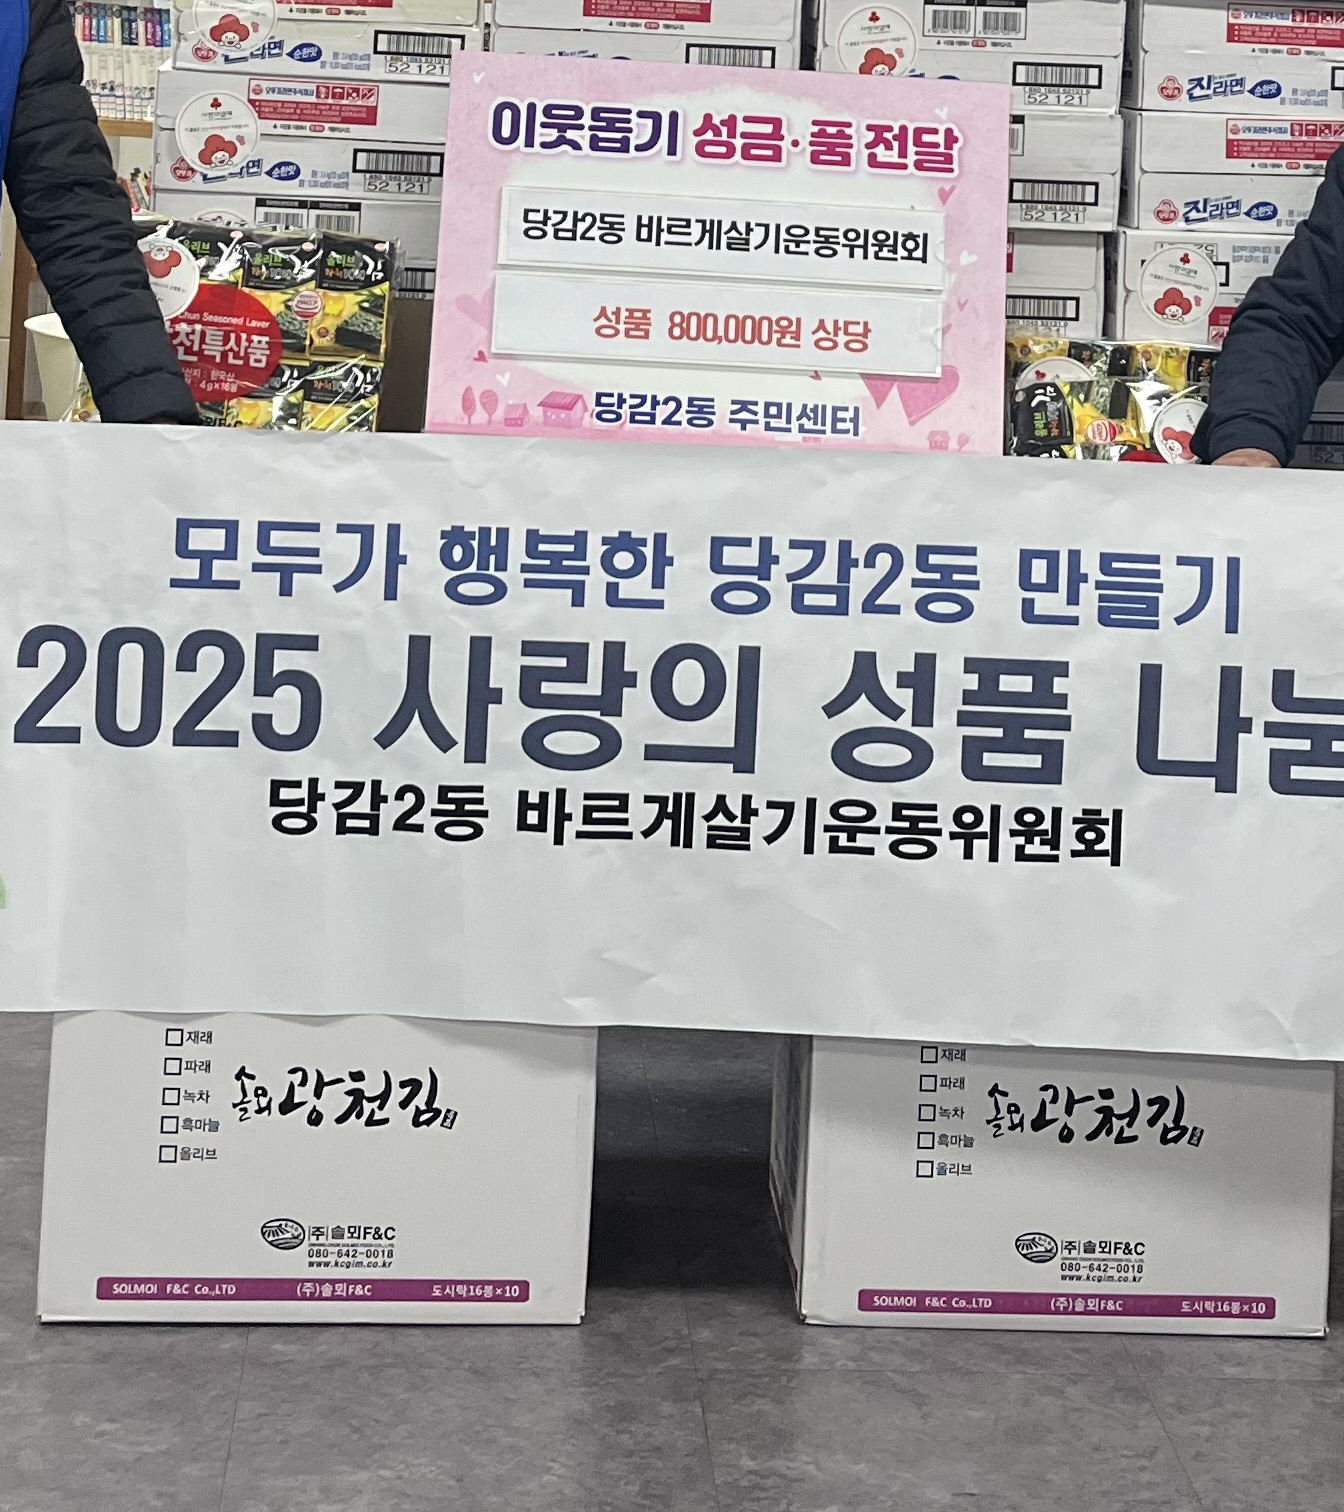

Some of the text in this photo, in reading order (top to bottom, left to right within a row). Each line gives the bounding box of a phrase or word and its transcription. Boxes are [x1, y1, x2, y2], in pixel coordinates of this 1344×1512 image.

[1186, 74, 1247, 102] 진라면
[492, 100, 680, 157] 이웃돕기
[864, 121, 961, 175] 전달
[1182, 197, 1242, 225] 진라면
[521, 206, 929, 265] 당감2동 바르게살기운동위원회
[202, 313, 244, 325] Seasoned
[246, 316, 271, 329] Laver
[593, 304, 872, 354] 성품 800,000원 상당
[165, 320, 271, 368] 천특산품
[594, 390, 862, 438] 당감2동 주민센터
[169, 517, 1242, 635] 모두가 행복한 당감2동 만들기
[13, 624, 323, 753] 2025
[373, 634, 761, 774] 사랑의
[821, 650, 1073, 786] 성품
[267, 776, 1125, 867] 당감2동 바르게살기운동위원회
[186, 1030, 213, 1045] 재래
[940, 1047, 967, 1062] 재래
[183, 1059, 211, 1074] 파래
[939, 1076, 965, 1091] 파래
[182, 1088, 210, 1104] 녹차
[278, 1066, 443, 1128] 광천김
[938, 1105, 965, 1120] 녹차
[1030, 1084, 1189, 1146] 광천김
[181, 1117, 220, 1134] 흑마늘
[937, 1133, 975, 1148] 흑마늘
[179, 1146, 218, 1161] 올리브
[936, 1161, 973, 1177] 올리브
[308, 1248, 394, 1258] 080-642-0018
[308, 1259, 393, 1269] www.kcgim.co.kr
[1061, 1261, 1144, 1274] 080-642-0018
[1061, 1273, 1143, 1283] www.kcgim.co.kr
[113, 1283, 157, 1294] SOLMOI
[166, 1283, 189, 1294] F&C
[873, 1295, 916, 1307] SOLMOI
[924, 1296, 947, 1308] F&C
